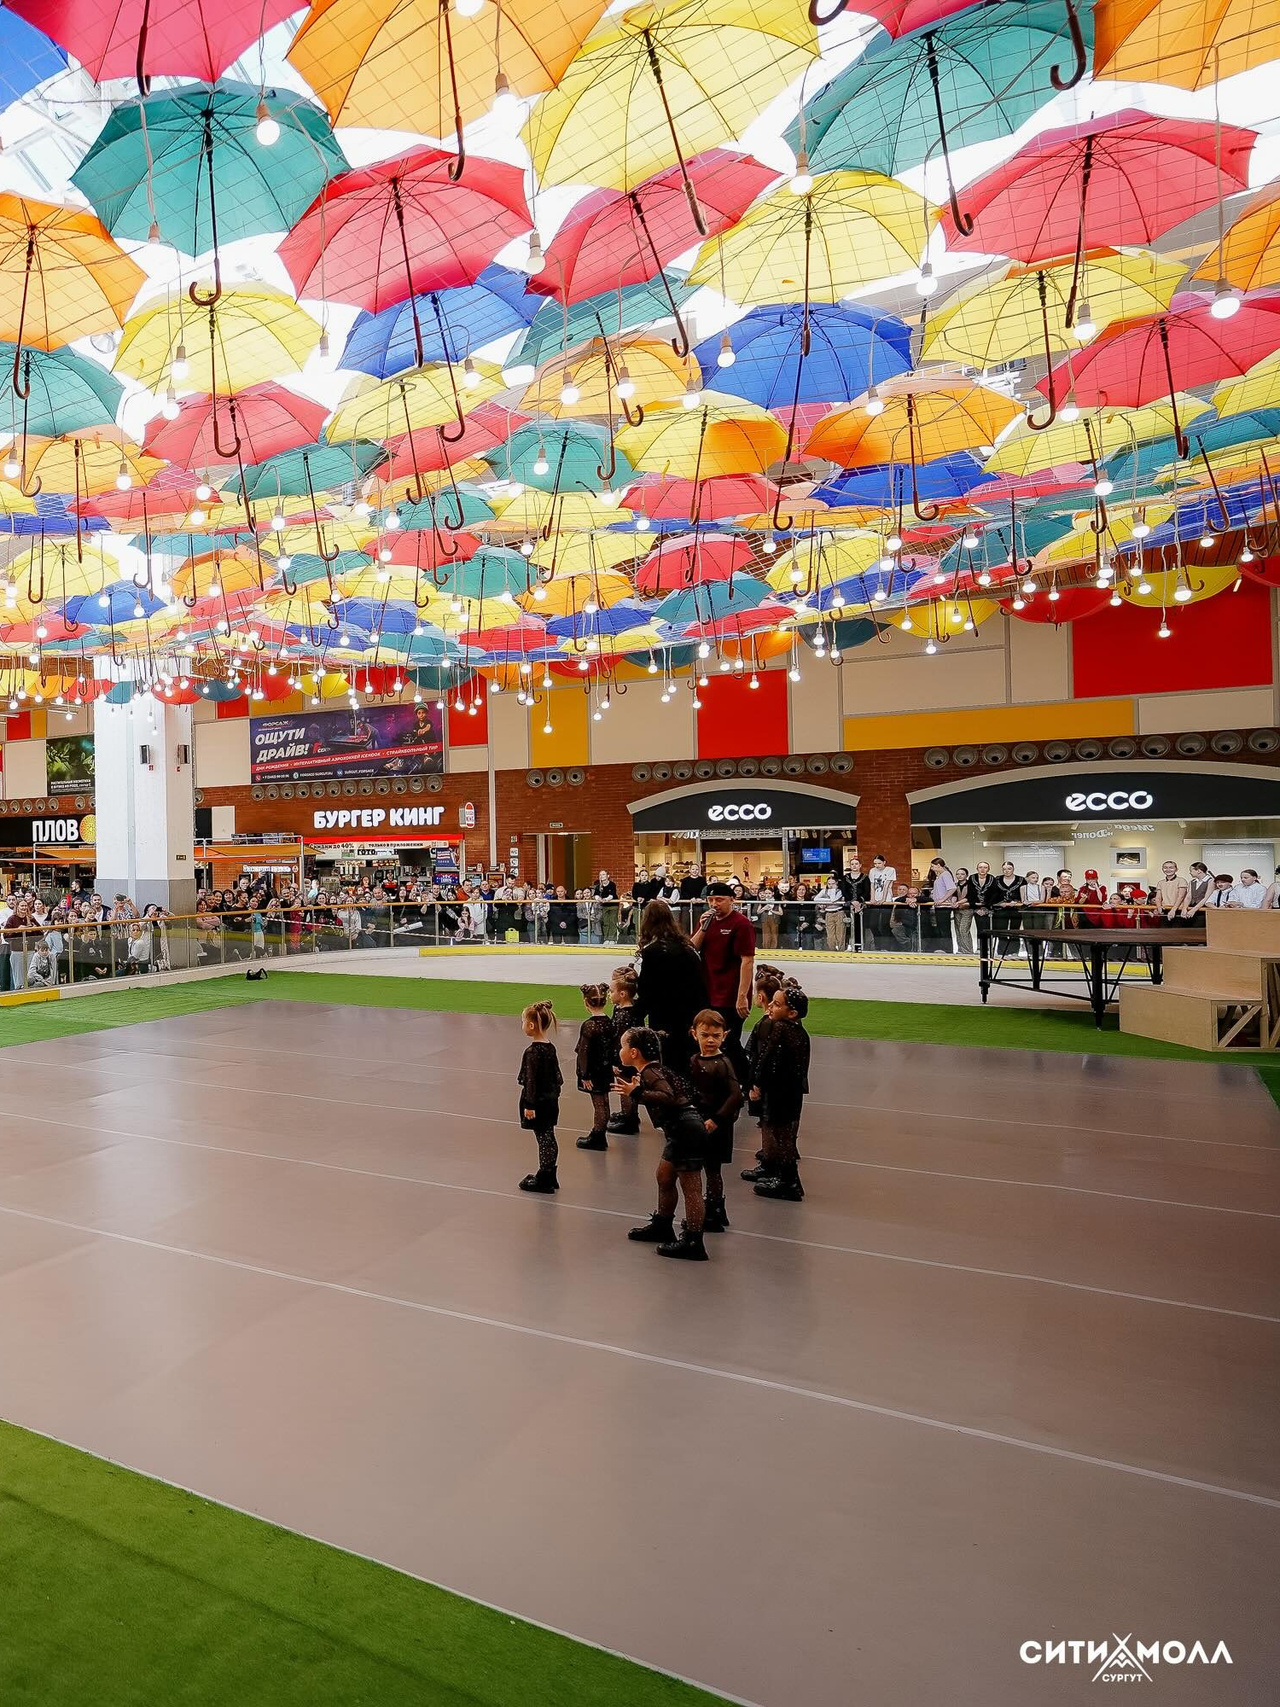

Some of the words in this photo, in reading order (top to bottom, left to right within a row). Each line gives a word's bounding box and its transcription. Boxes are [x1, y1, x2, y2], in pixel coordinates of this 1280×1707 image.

[255, 727, 306, 746] ОЩУТИ
[256, 742, 310, 764] ДРАЙВ!
[1065, 790, 1154, 812] ecco
[313, 808, 386, 829] БУРГЕР
[389, 806, 445, 827] КИНГ
[707, 803, 772, 822] ecco
[32, 819, 79, 842] ПЛОВ
[341, 842, 355, 850] 40%
